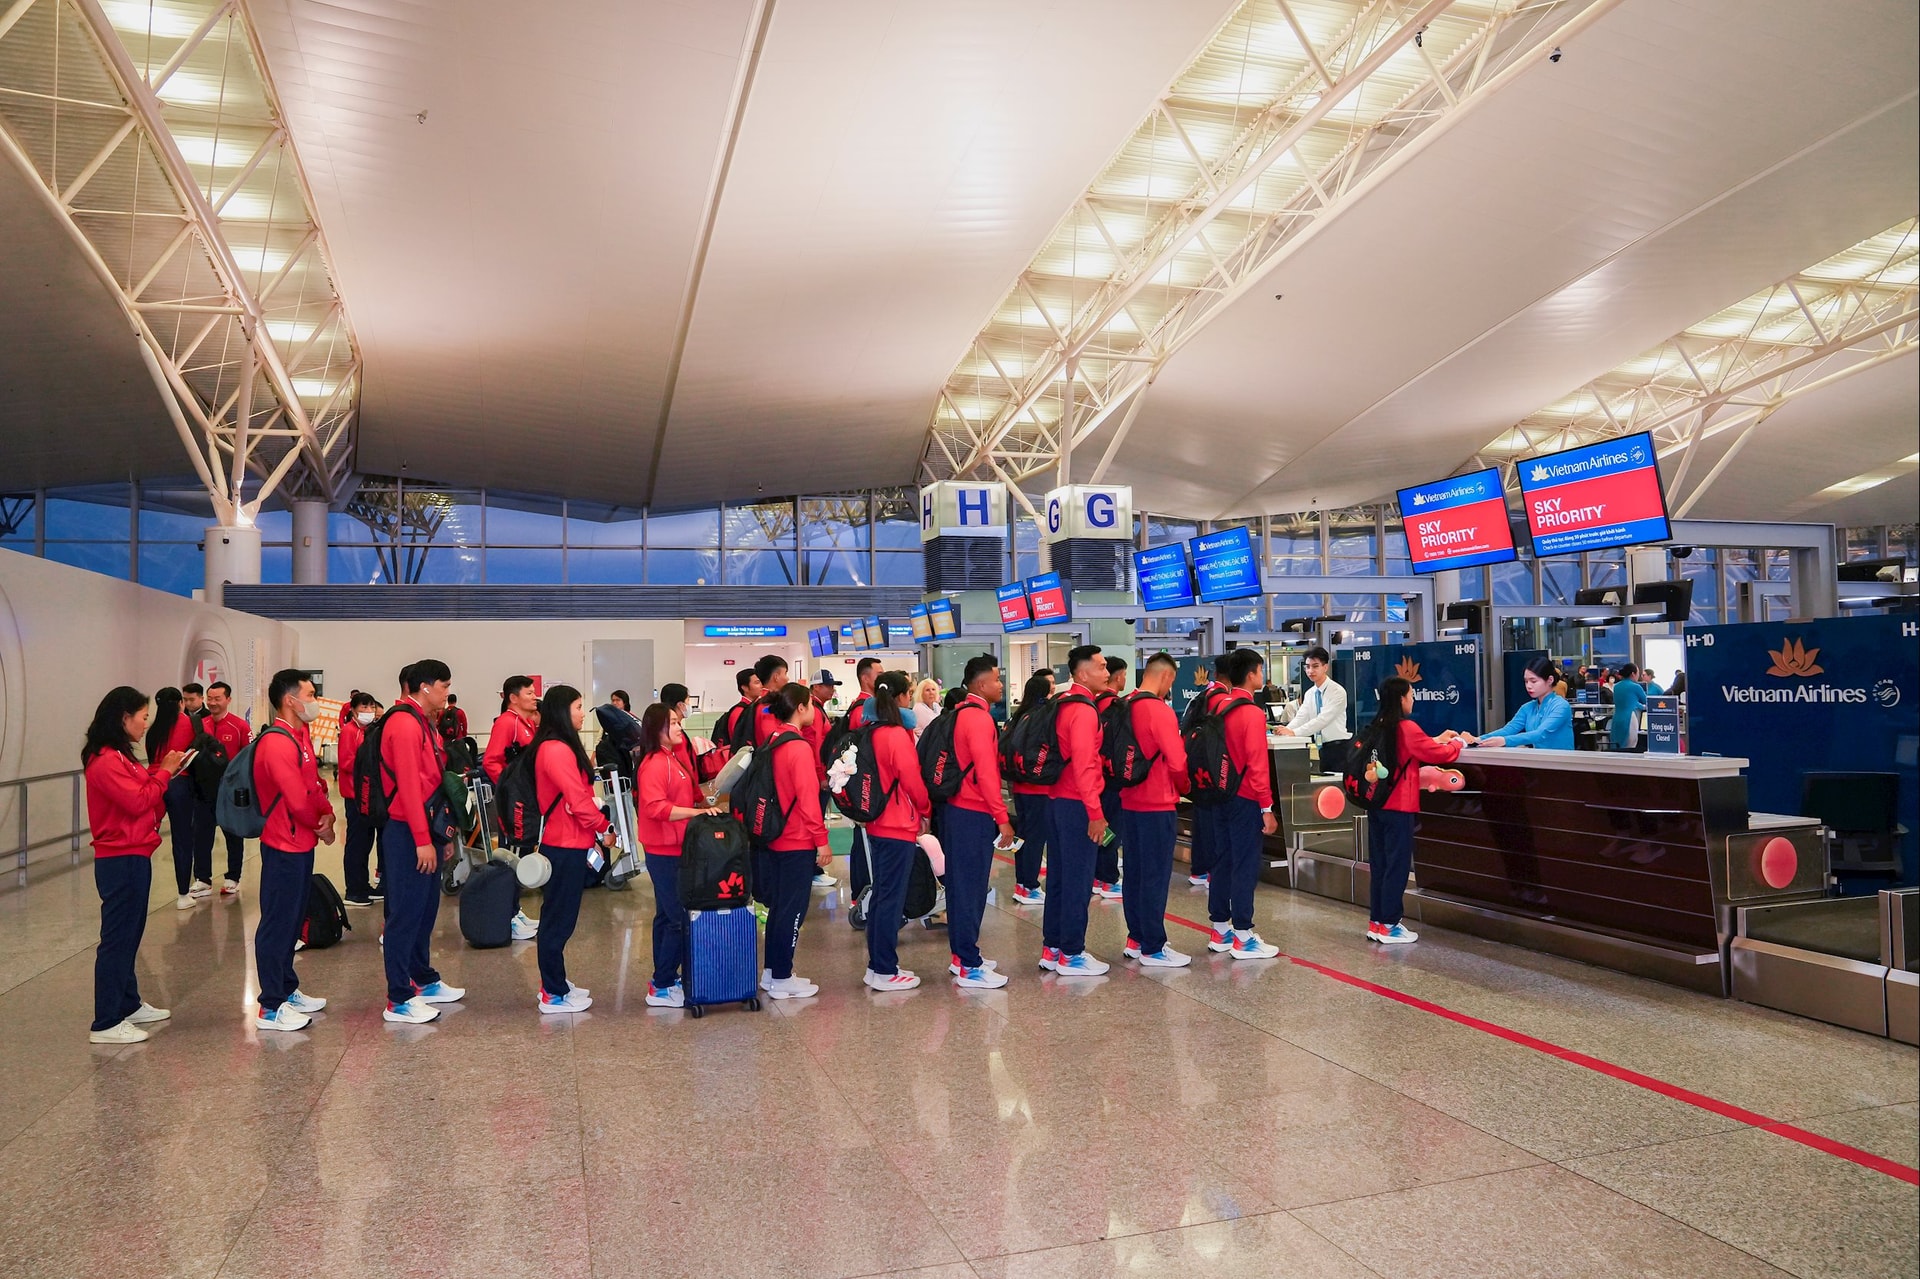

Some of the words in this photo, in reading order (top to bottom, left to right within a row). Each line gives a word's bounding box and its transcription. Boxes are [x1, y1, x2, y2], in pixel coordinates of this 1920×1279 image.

[923, 492, 932, 530] H
[958, 490, 989, 526] H
[1048, 498, 1060, 534] G
[1086, 493, 1115, 528] G
[1534, 498, 1562, 514] SKY
[1536, 504, 1603, 528] PRIORITY
[1418, 520, 1441, 535] SKY
[1421, 528, 1475, 548] PRIORITY
[1455, 644, 1475, 655] H-09
[1686, 633, 1715, 647] H-10
[1355, 652, 1371, 660] H-08
